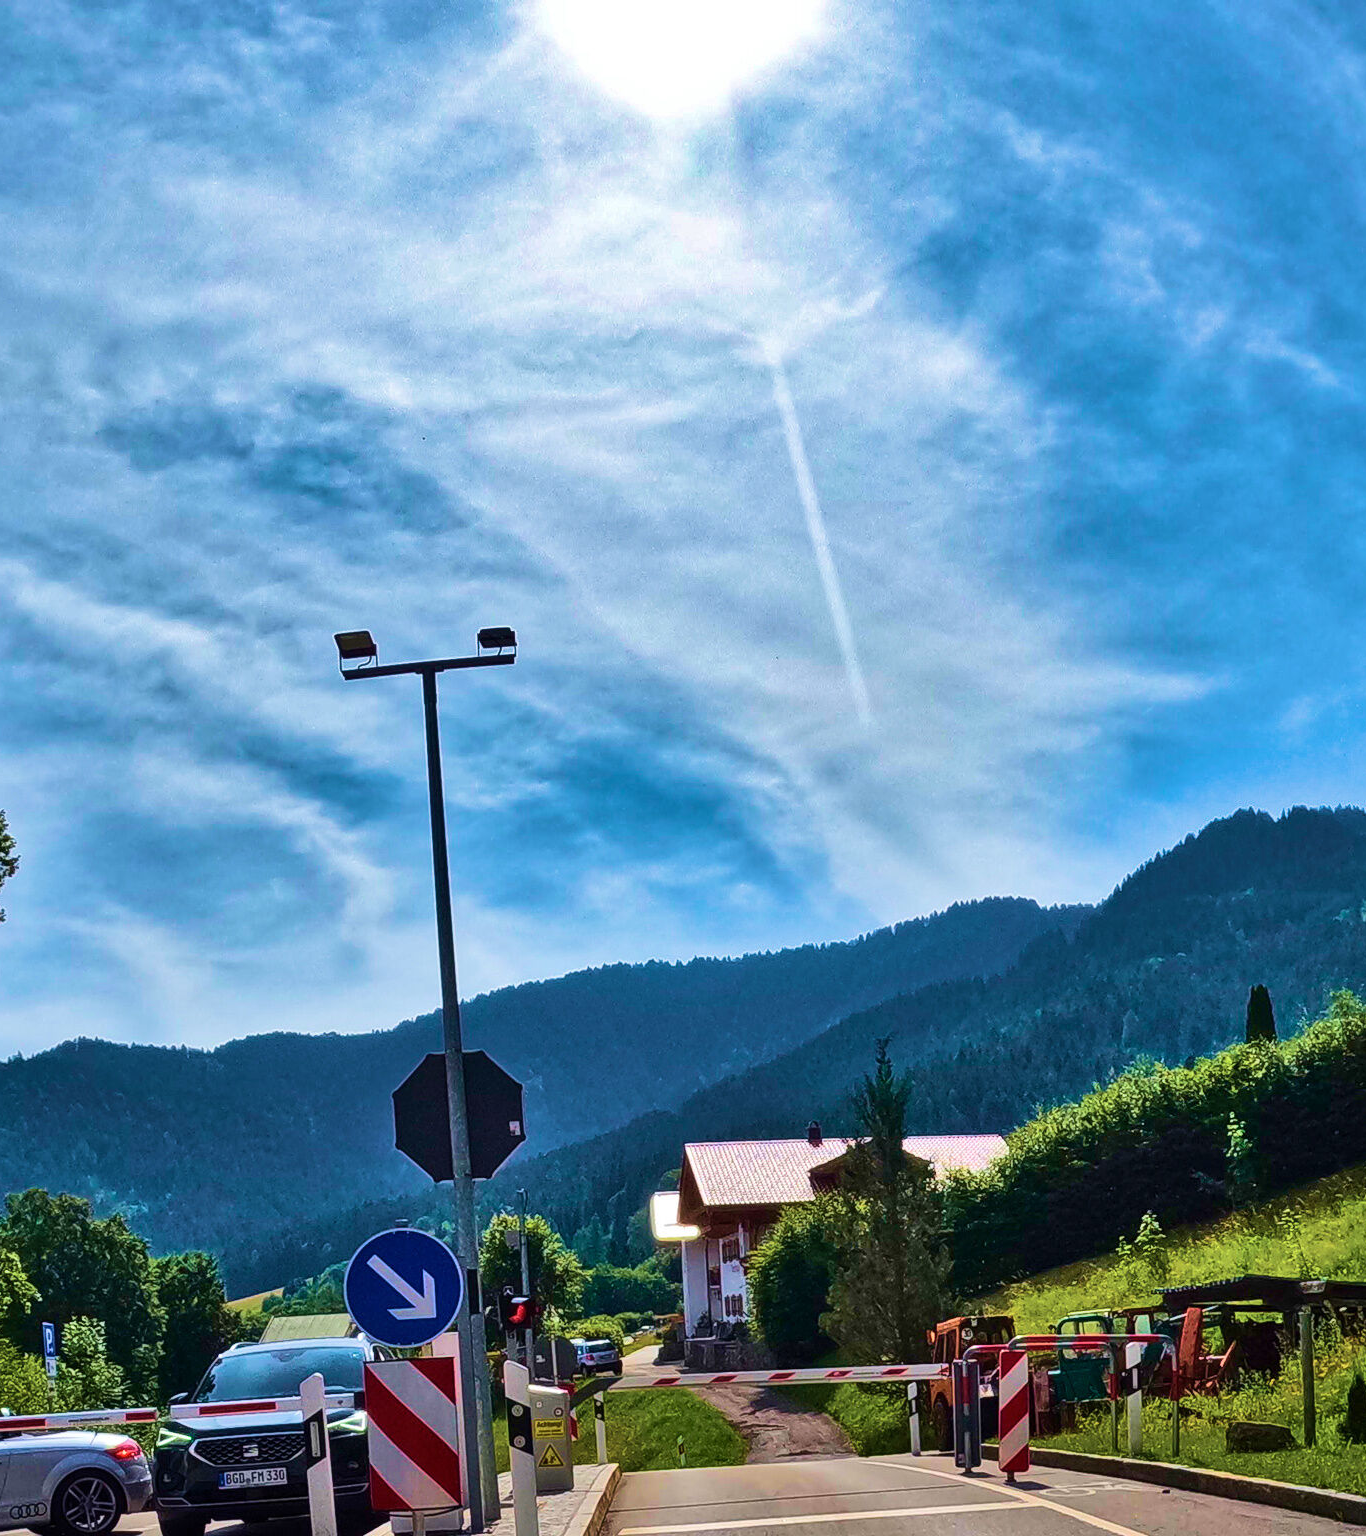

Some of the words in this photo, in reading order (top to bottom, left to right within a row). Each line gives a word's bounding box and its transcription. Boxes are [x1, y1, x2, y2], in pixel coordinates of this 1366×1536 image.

[45, 1328, 53, 1354] P
[226, 1472, 245, 1485] BGD
[251, 1471, 265, 1483] FM
[266, 1469, 285, 1481] 330
